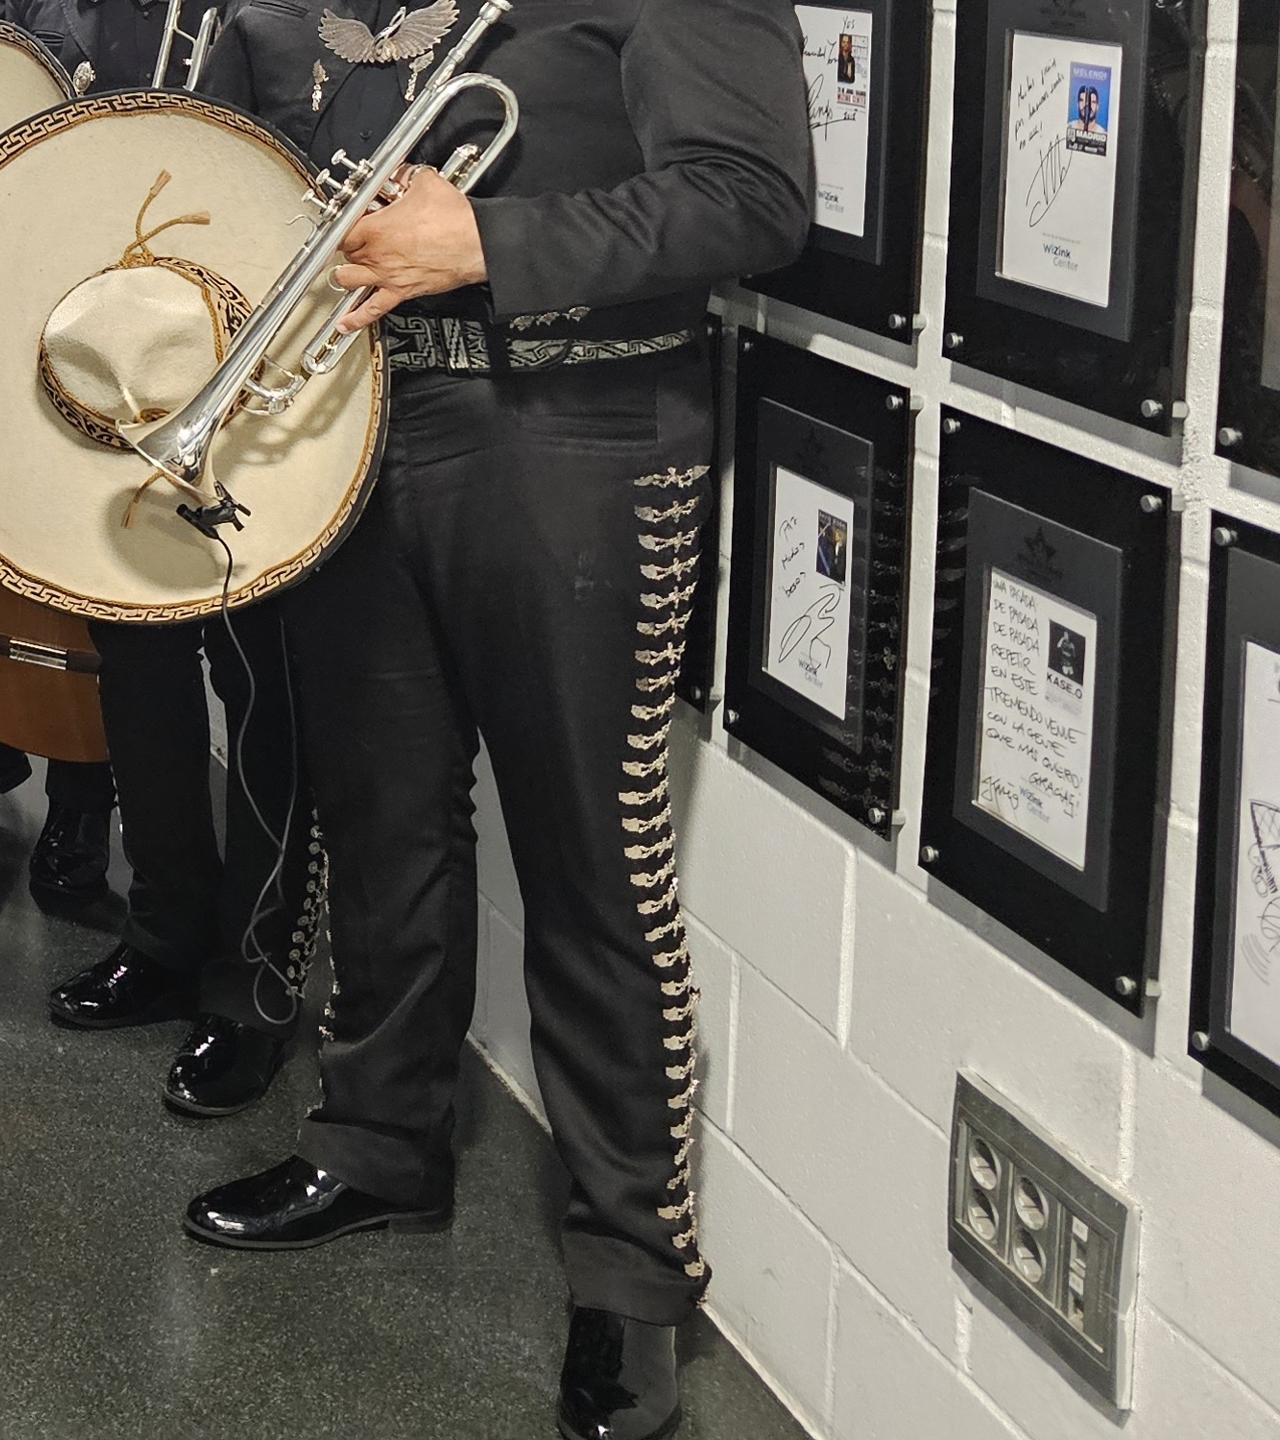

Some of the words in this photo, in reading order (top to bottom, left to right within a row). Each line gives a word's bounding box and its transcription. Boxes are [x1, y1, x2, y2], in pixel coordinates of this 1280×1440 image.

[1076, 129, 1107, 143] MADRID
[1043, 242, 1071, 259] WiZink
[994, 599, 1007, 615] DE
[993, 621, 1008, 637] DE
[991, 665, 1008, 679] EN
